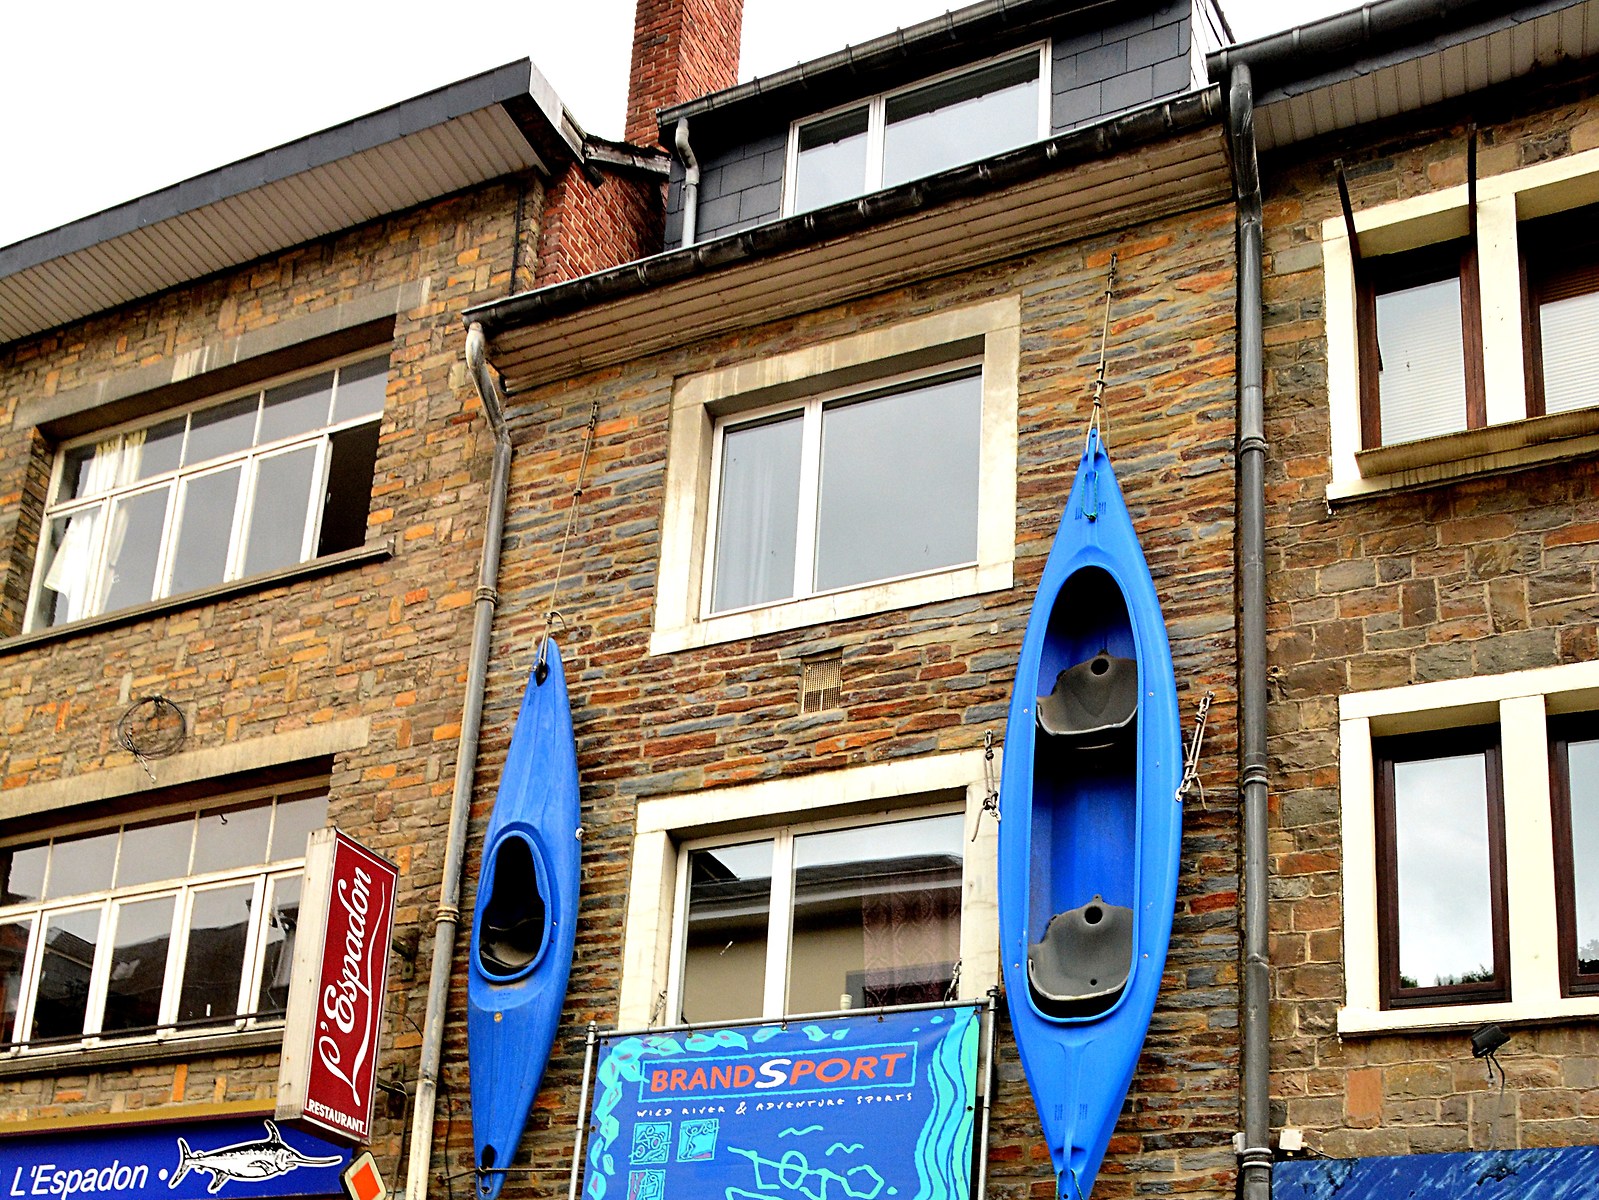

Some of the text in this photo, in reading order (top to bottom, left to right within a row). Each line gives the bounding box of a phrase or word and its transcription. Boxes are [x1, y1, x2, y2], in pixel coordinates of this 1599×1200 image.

[318, 866, 376, 1106] L'Espadon
[651, 1053, 907, 1092] BRANDSPORT
[308, 1098, 367, 1134] RESTAURANT
[637, 1093, 912, 1118] WILD RIVER & ADVENTURE SPORTS
[10, 1160, 149, 1200] L'Espadon
